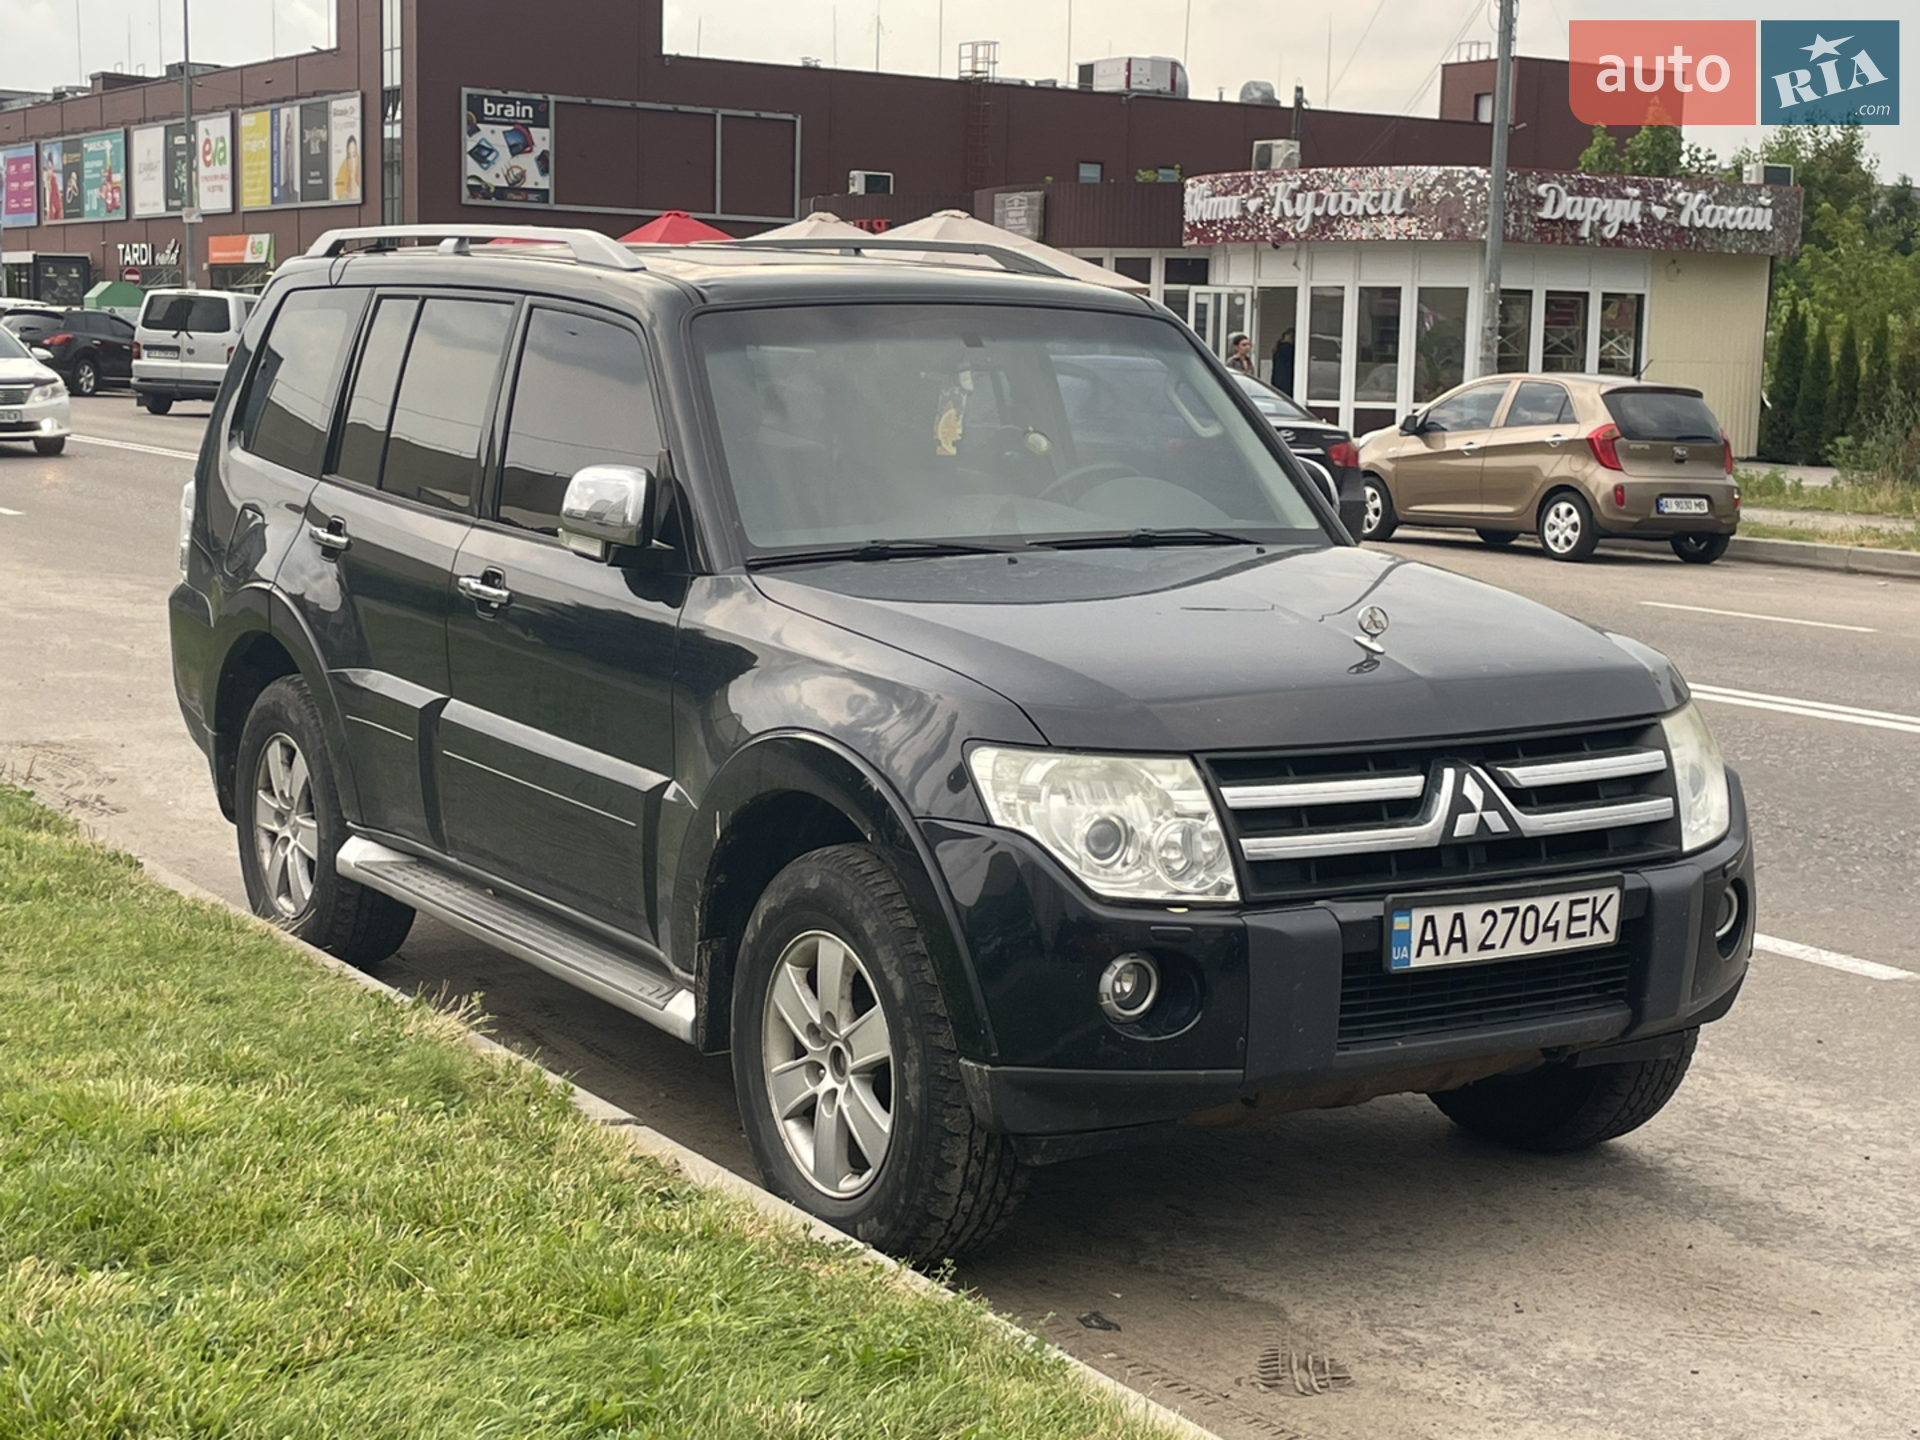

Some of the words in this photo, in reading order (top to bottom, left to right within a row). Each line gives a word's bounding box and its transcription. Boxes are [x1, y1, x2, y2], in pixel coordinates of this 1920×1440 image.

[483, 98, 533, 119] brain
[1269, 180, 1408, 232] Кульки
[1537, 183, 1642, 240] Даруй
[1676, 190, 1773, 231] Кохай
[117, 243, 152, 266] TARDI
[1392, 946, 1409, 960] UA
